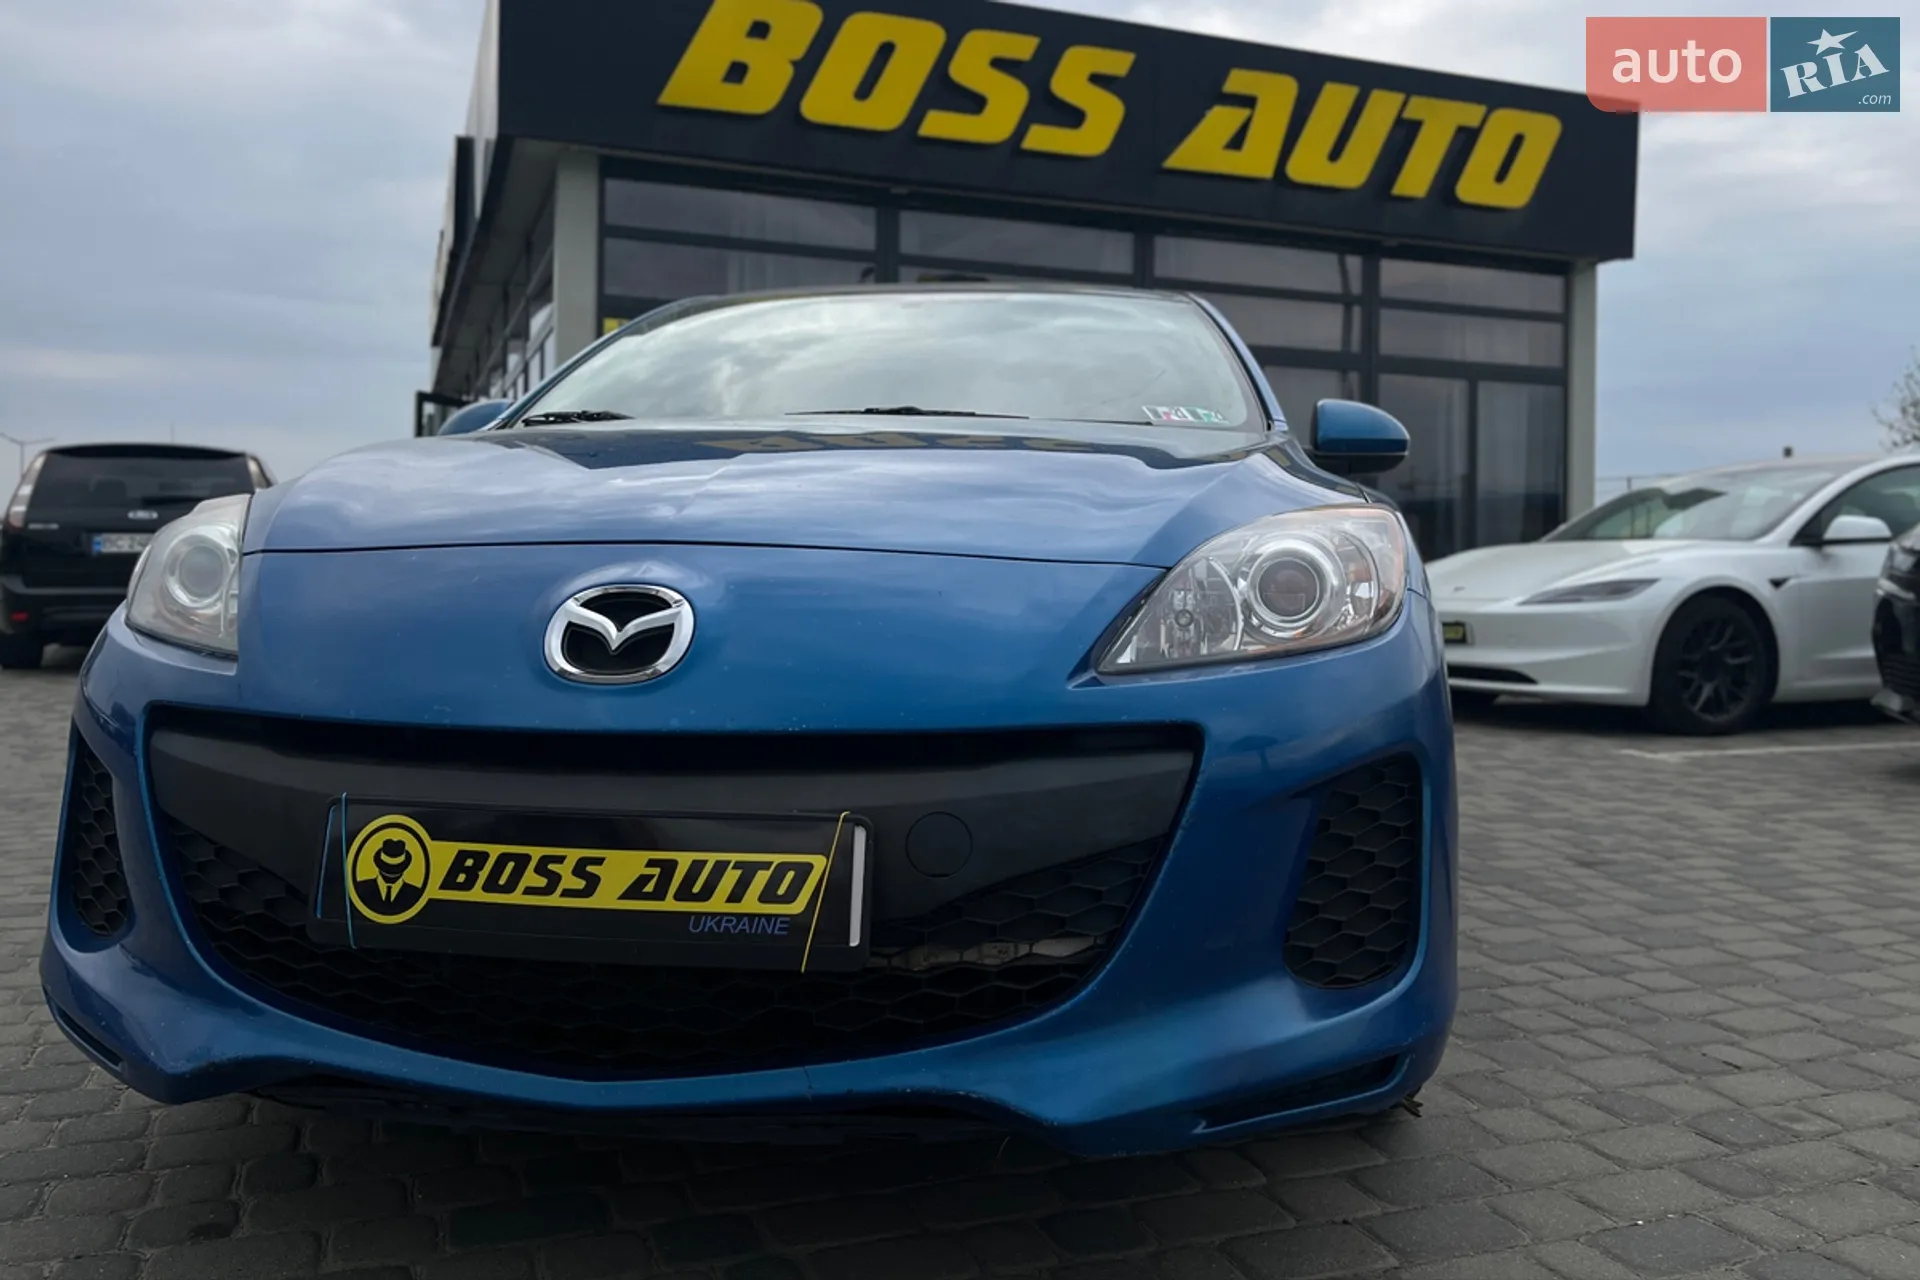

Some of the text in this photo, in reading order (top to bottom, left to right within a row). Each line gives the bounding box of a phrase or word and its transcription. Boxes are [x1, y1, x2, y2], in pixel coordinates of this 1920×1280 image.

[658, 0, 1562, 209] BOSS AUTO
[438, 849, 814, 905] BOSS AUTO
[689, 915, 789, 935] UKRAINE
